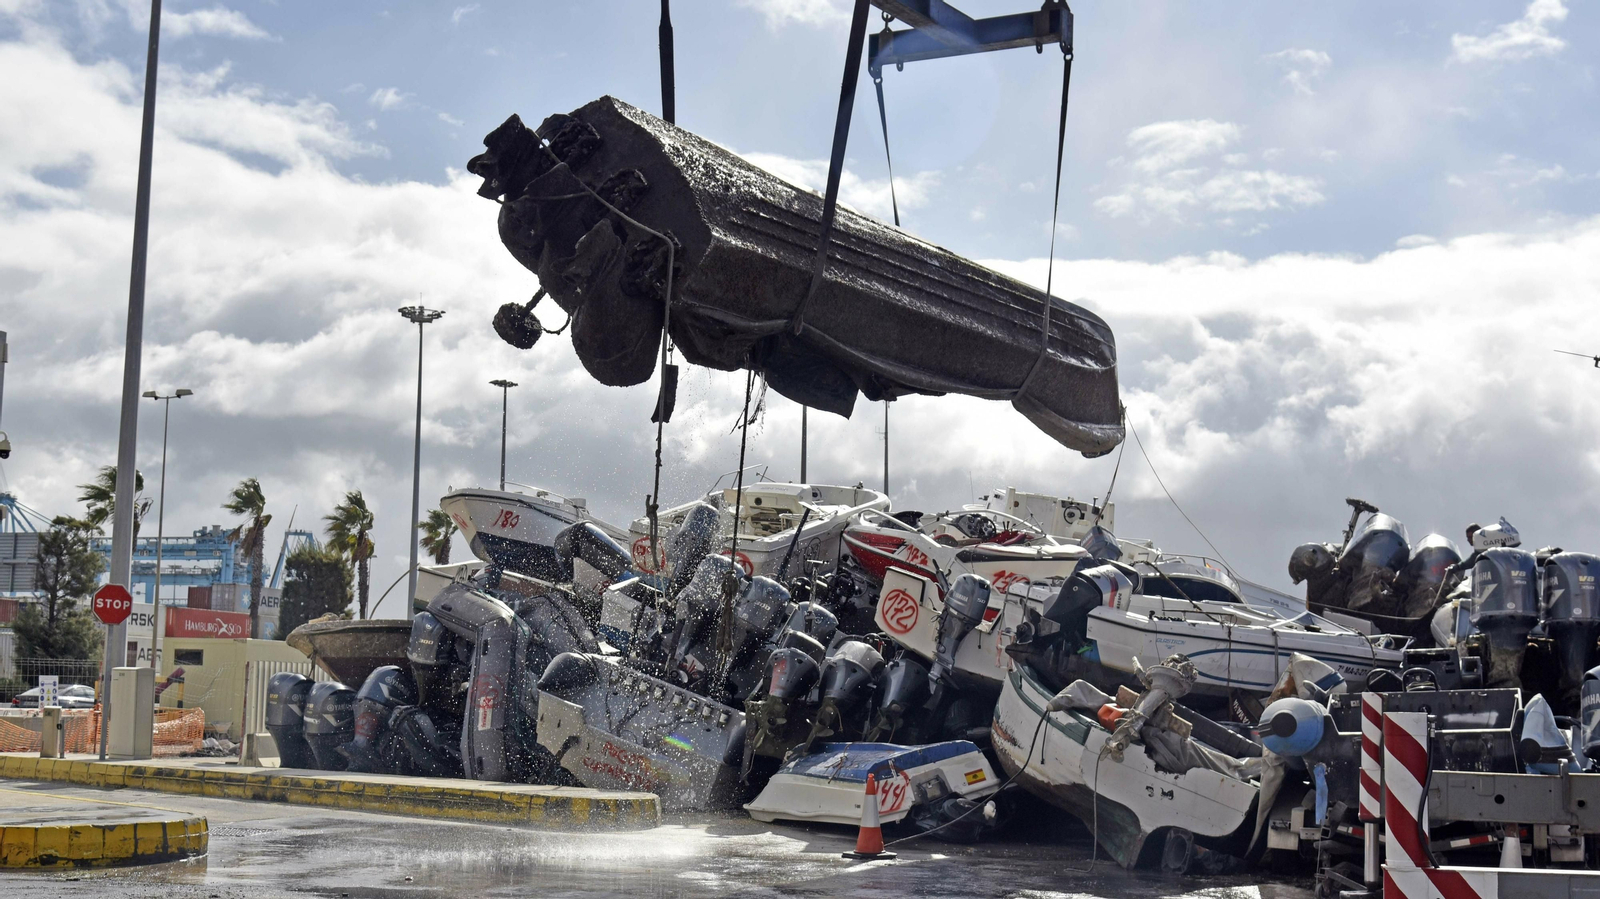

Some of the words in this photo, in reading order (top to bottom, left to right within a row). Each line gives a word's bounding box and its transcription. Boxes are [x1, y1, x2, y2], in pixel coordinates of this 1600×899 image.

[492, 508, 520, 529] 180
[1482, 537, 1516, 547] GARMIN
[96, 598, 131, 610] STOP
[260, 596, 281, 608] AER
[883, 591, 917, 630] 172
[128, 612, 155, 627] RSK
[184, 619, 217, 632] HAMBURG
